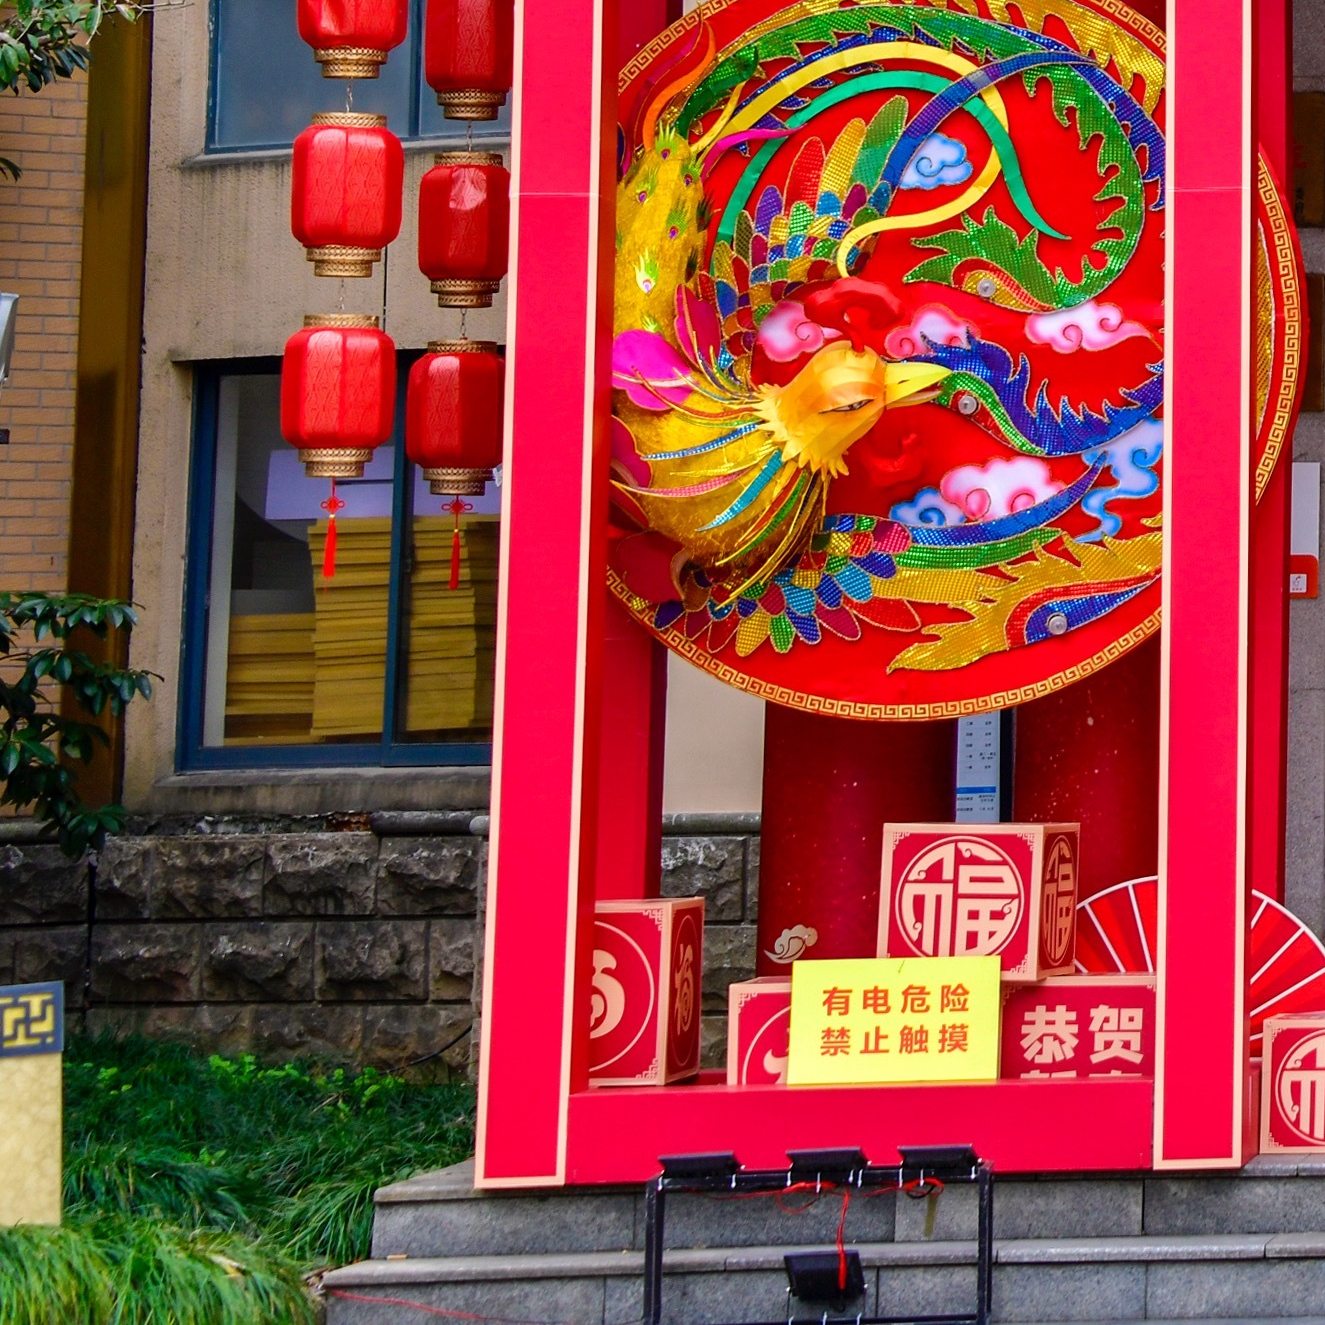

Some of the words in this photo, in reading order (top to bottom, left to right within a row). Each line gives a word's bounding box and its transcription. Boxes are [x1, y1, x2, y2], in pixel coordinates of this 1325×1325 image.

[900, 840, 1020, 956] 福
[821, 982, 971, 1017] 有电危险
[819, 1023, 970, 1057] 禁止触摸
[1019, 1003, 1144, 1064] 恭贺
